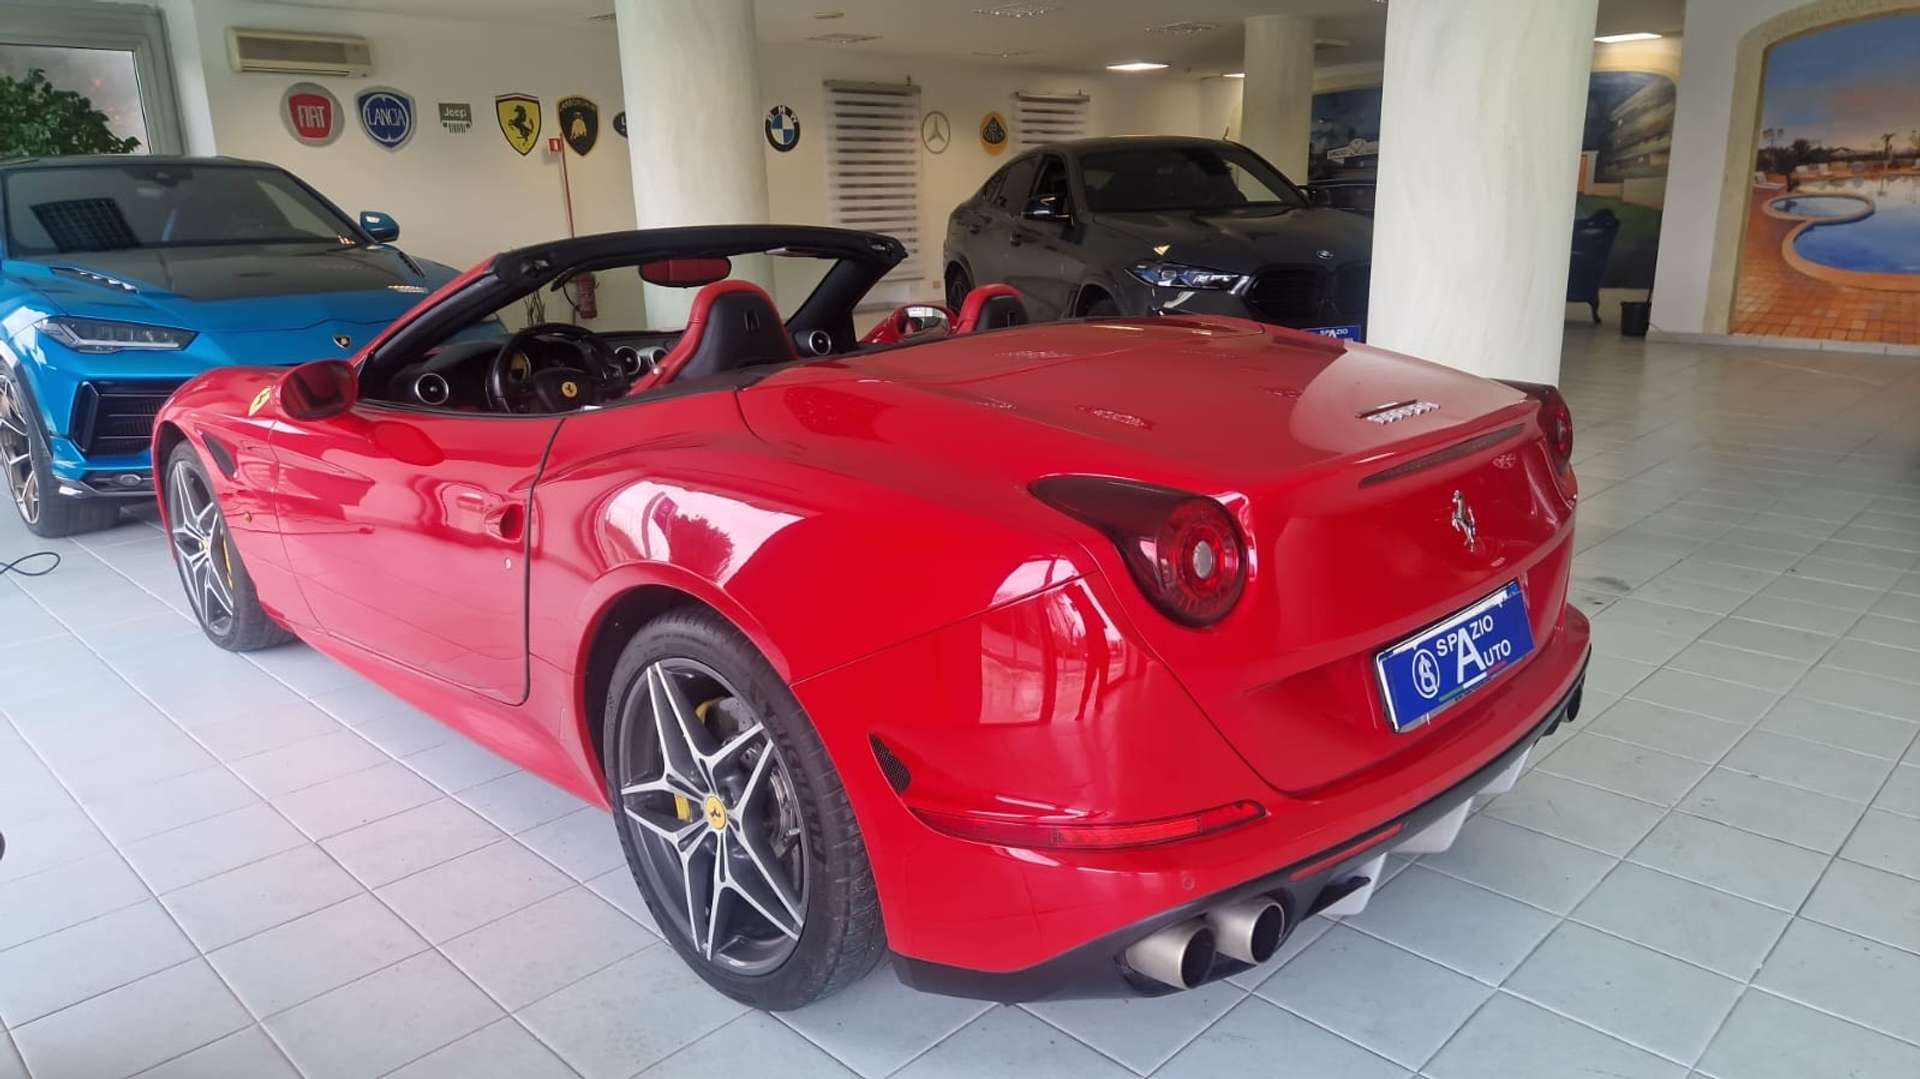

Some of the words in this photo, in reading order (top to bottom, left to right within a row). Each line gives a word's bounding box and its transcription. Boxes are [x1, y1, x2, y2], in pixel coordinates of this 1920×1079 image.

[297, 104, 326, 129] FIAT
[366, 107, 407, 127] LANCIA
[444, 106, 467, 119] Jeep
[768, 104, 798, 122] BMW
[1436, 615, 1494, 684] SPAZIO
